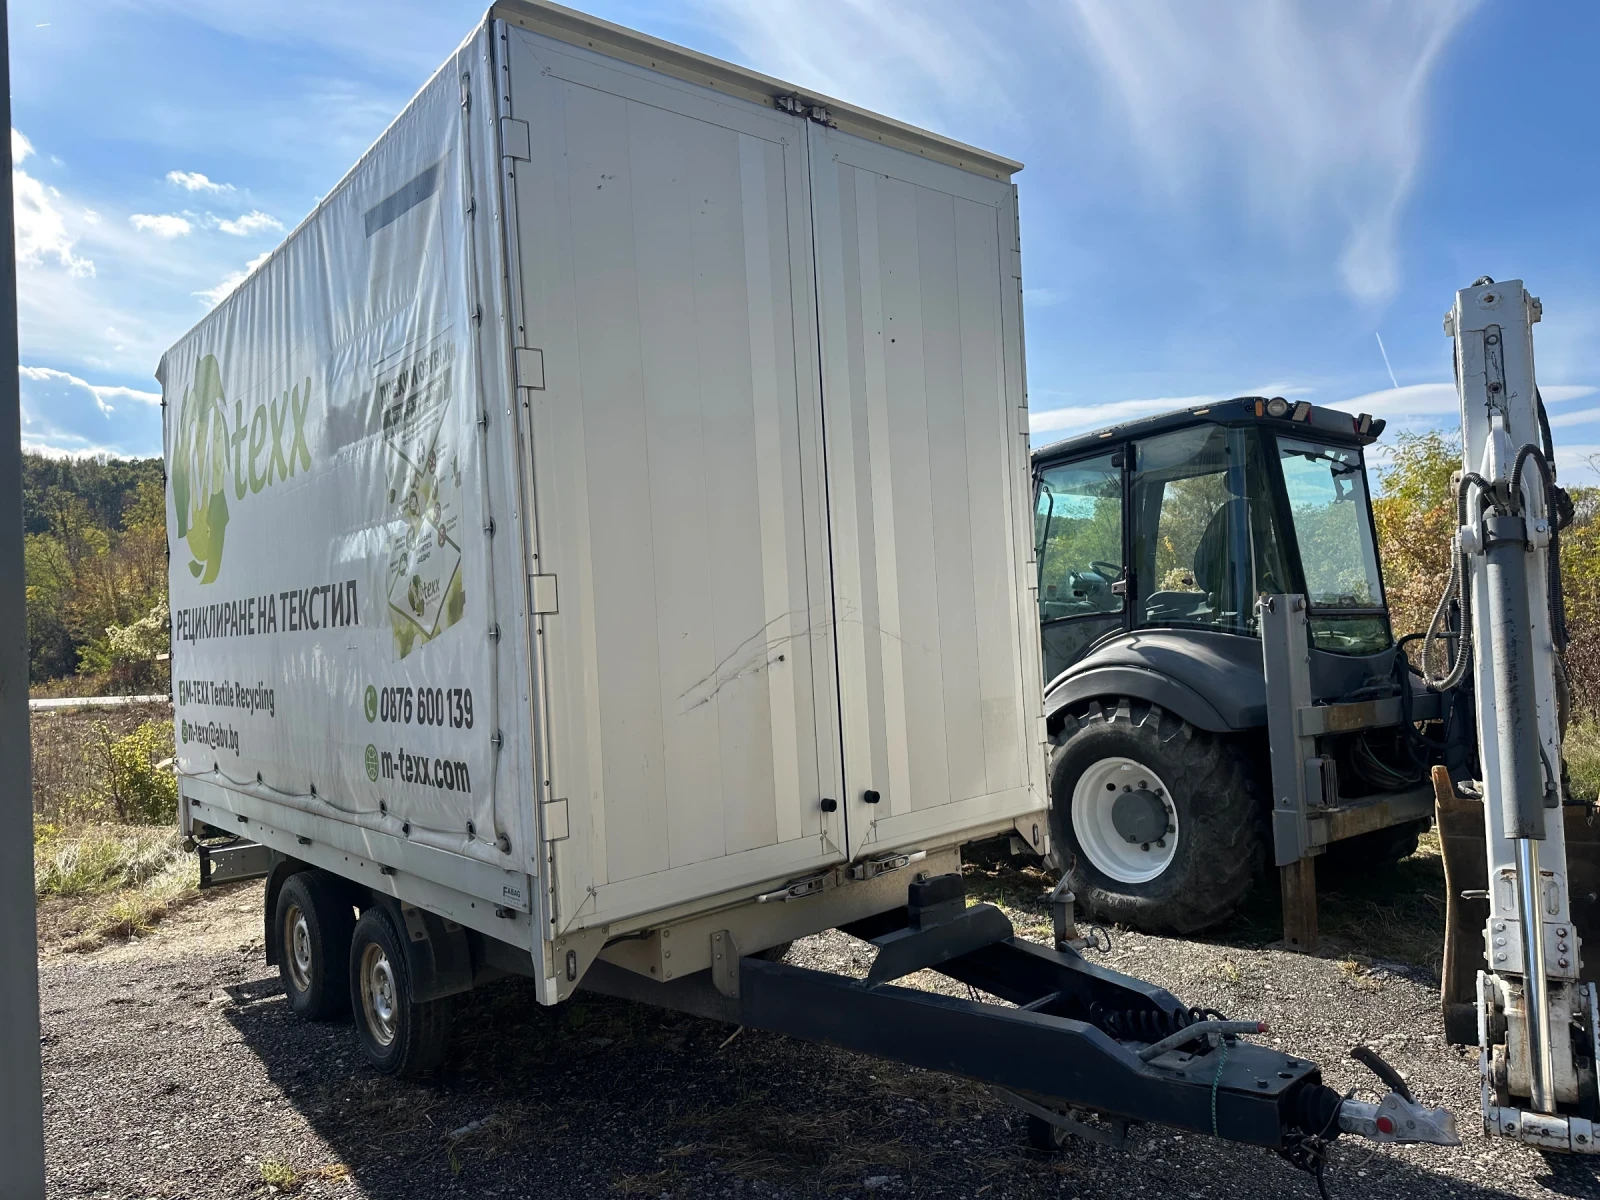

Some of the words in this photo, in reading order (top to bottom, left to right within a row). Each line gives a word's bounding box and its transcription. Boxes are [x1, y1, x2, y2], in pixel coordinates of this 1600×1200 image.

[176, 597, 255, 646] РЕЦИКЛИРАНЕ
[257, 594, 277, 634] НА
[279, 579, 359, 632] ТЕКСТИЛ
[186, 680, 210, 705] M-TEXX
[210, 680, 234, 707] Textile
[235, 680, 275, 718] Recycling
[380, 687, 413, 724] 0876
[417, 687, 444, 726] 600
[446, 688, 474, 729] 139
[188, 721, 239, 757] m-texx@abv.bg
[381, 747, 472, 793] m-texx.com
[502, 886, 521, 899] FABAG
